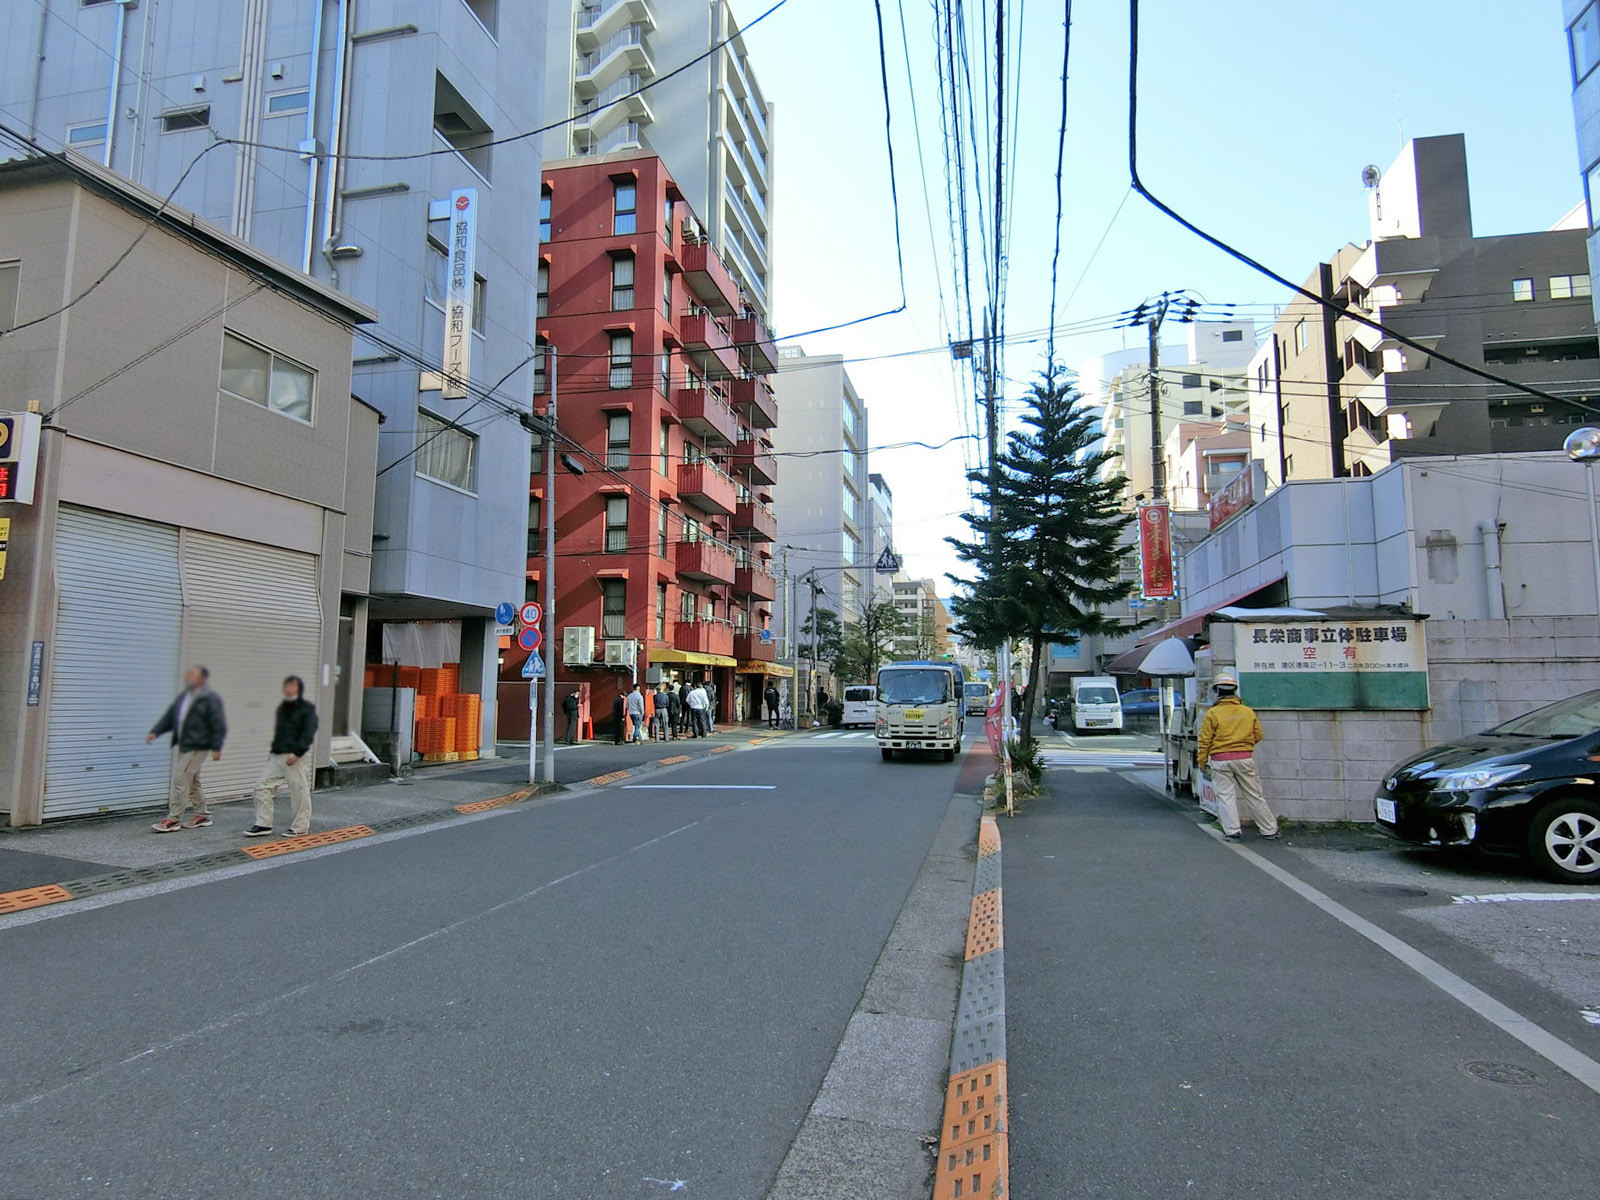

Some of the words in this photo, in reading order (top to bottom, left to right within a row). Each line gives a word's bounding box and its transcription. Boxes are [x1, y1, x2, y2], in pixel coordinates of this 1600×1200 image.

[524, 608, 537, 619] 40
[1253, 627, 1407, 644] 長栄商事立体駐車場
[1303, 646, 1317, 659] 空
[1343, 646, 1356, 659] 有
